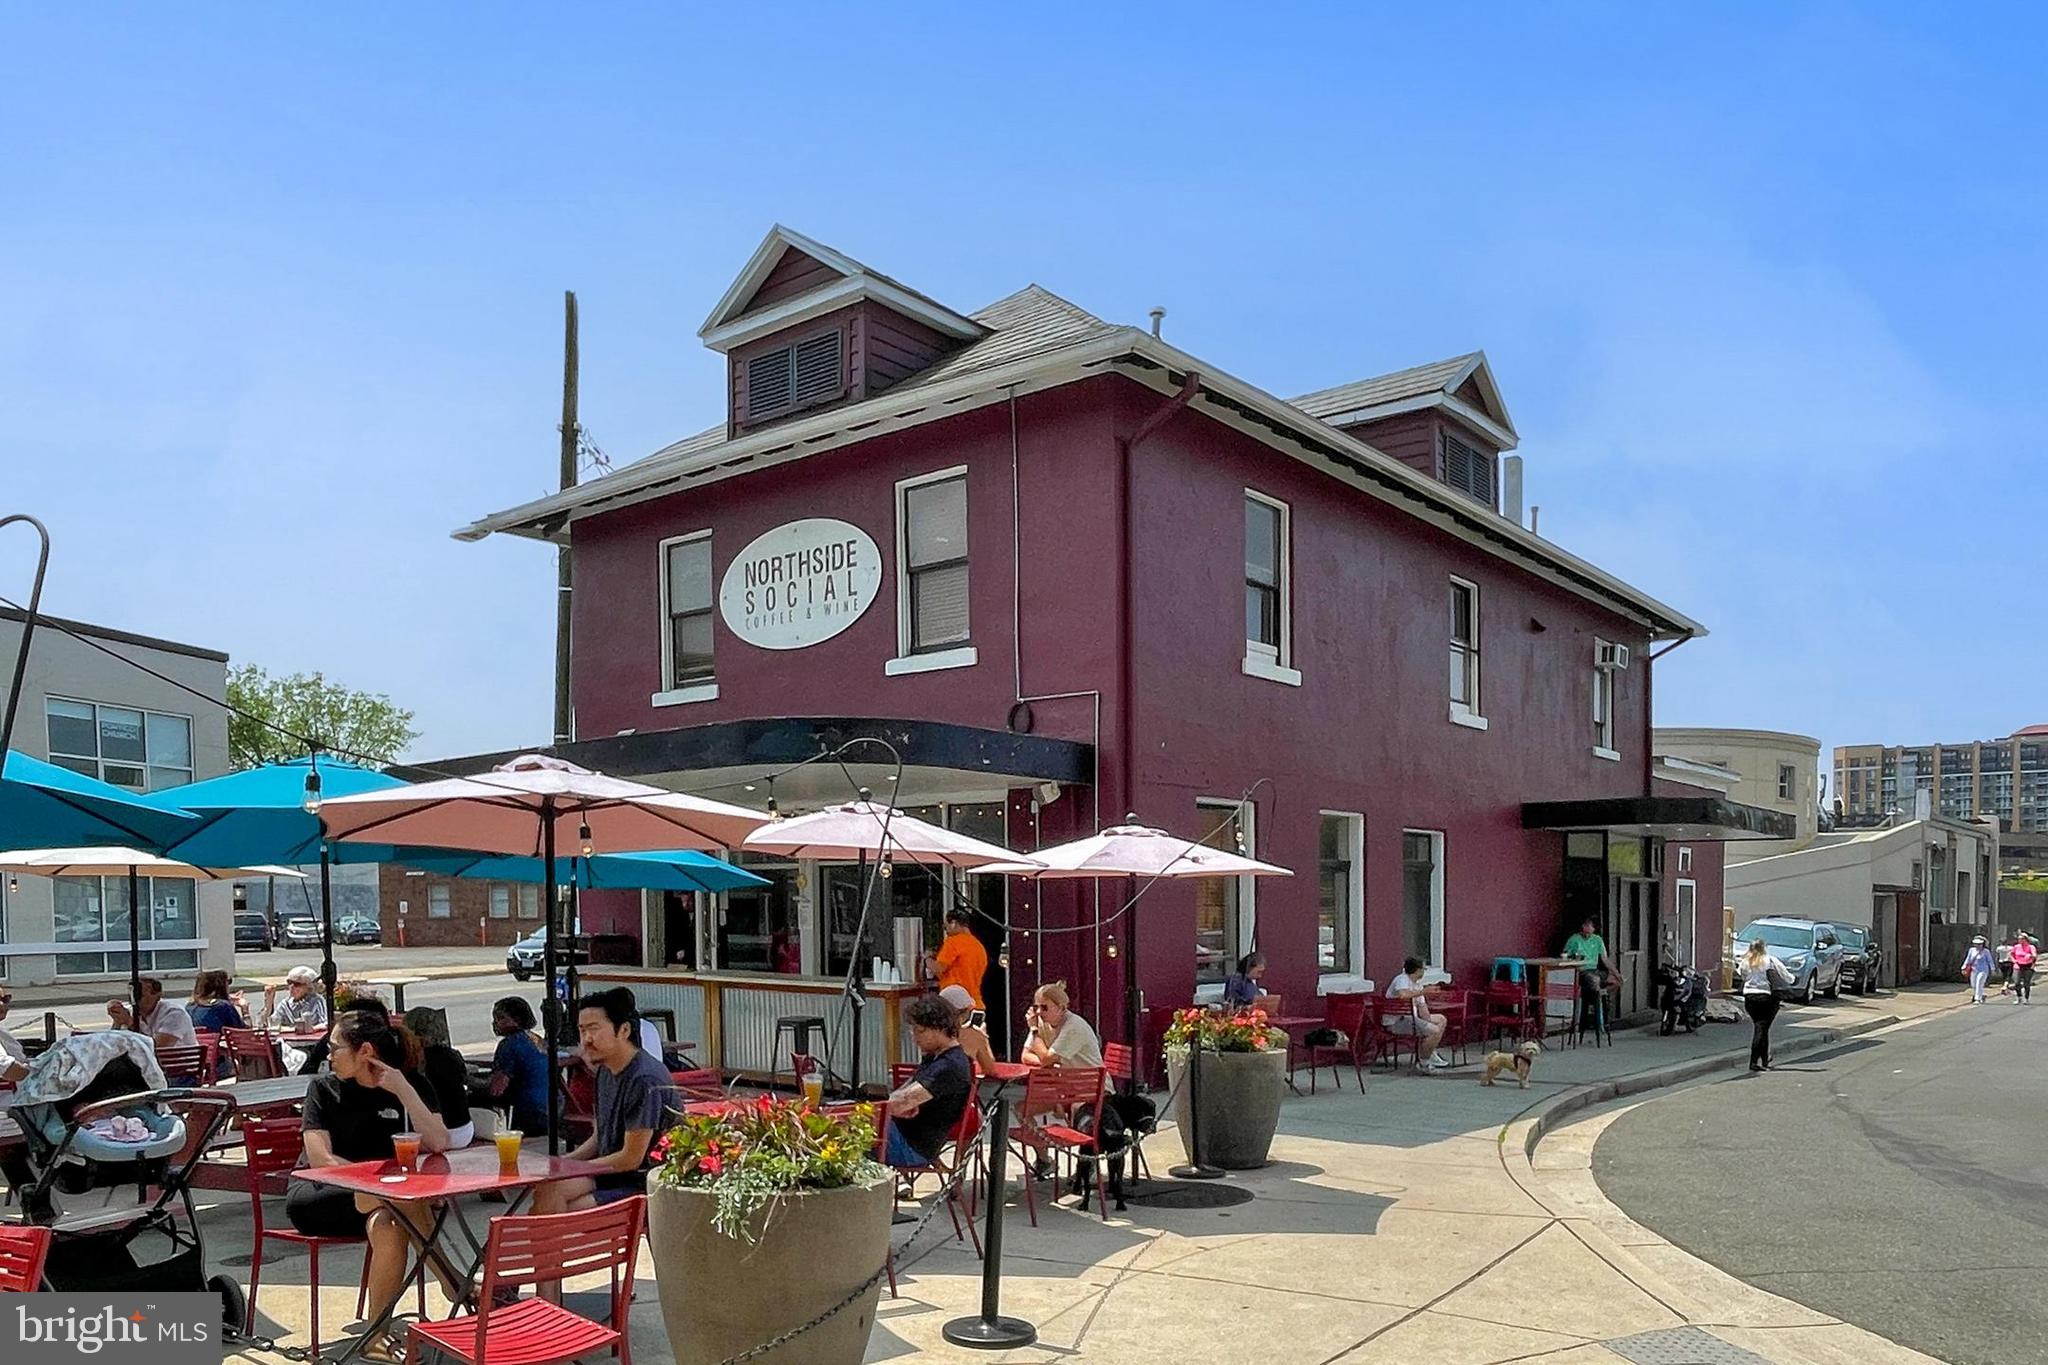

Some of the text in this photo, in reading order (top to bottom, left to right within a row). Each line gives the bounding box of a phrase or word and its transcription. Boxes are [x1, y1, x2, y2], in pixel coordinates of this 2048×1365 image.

[745, 540, 857, 588] NORTHSIDE
[745, 570, 857, 615] SOCIAL
[745, 610, 793, 630] COFFEE
[824, 599, 858, 616] WINE
